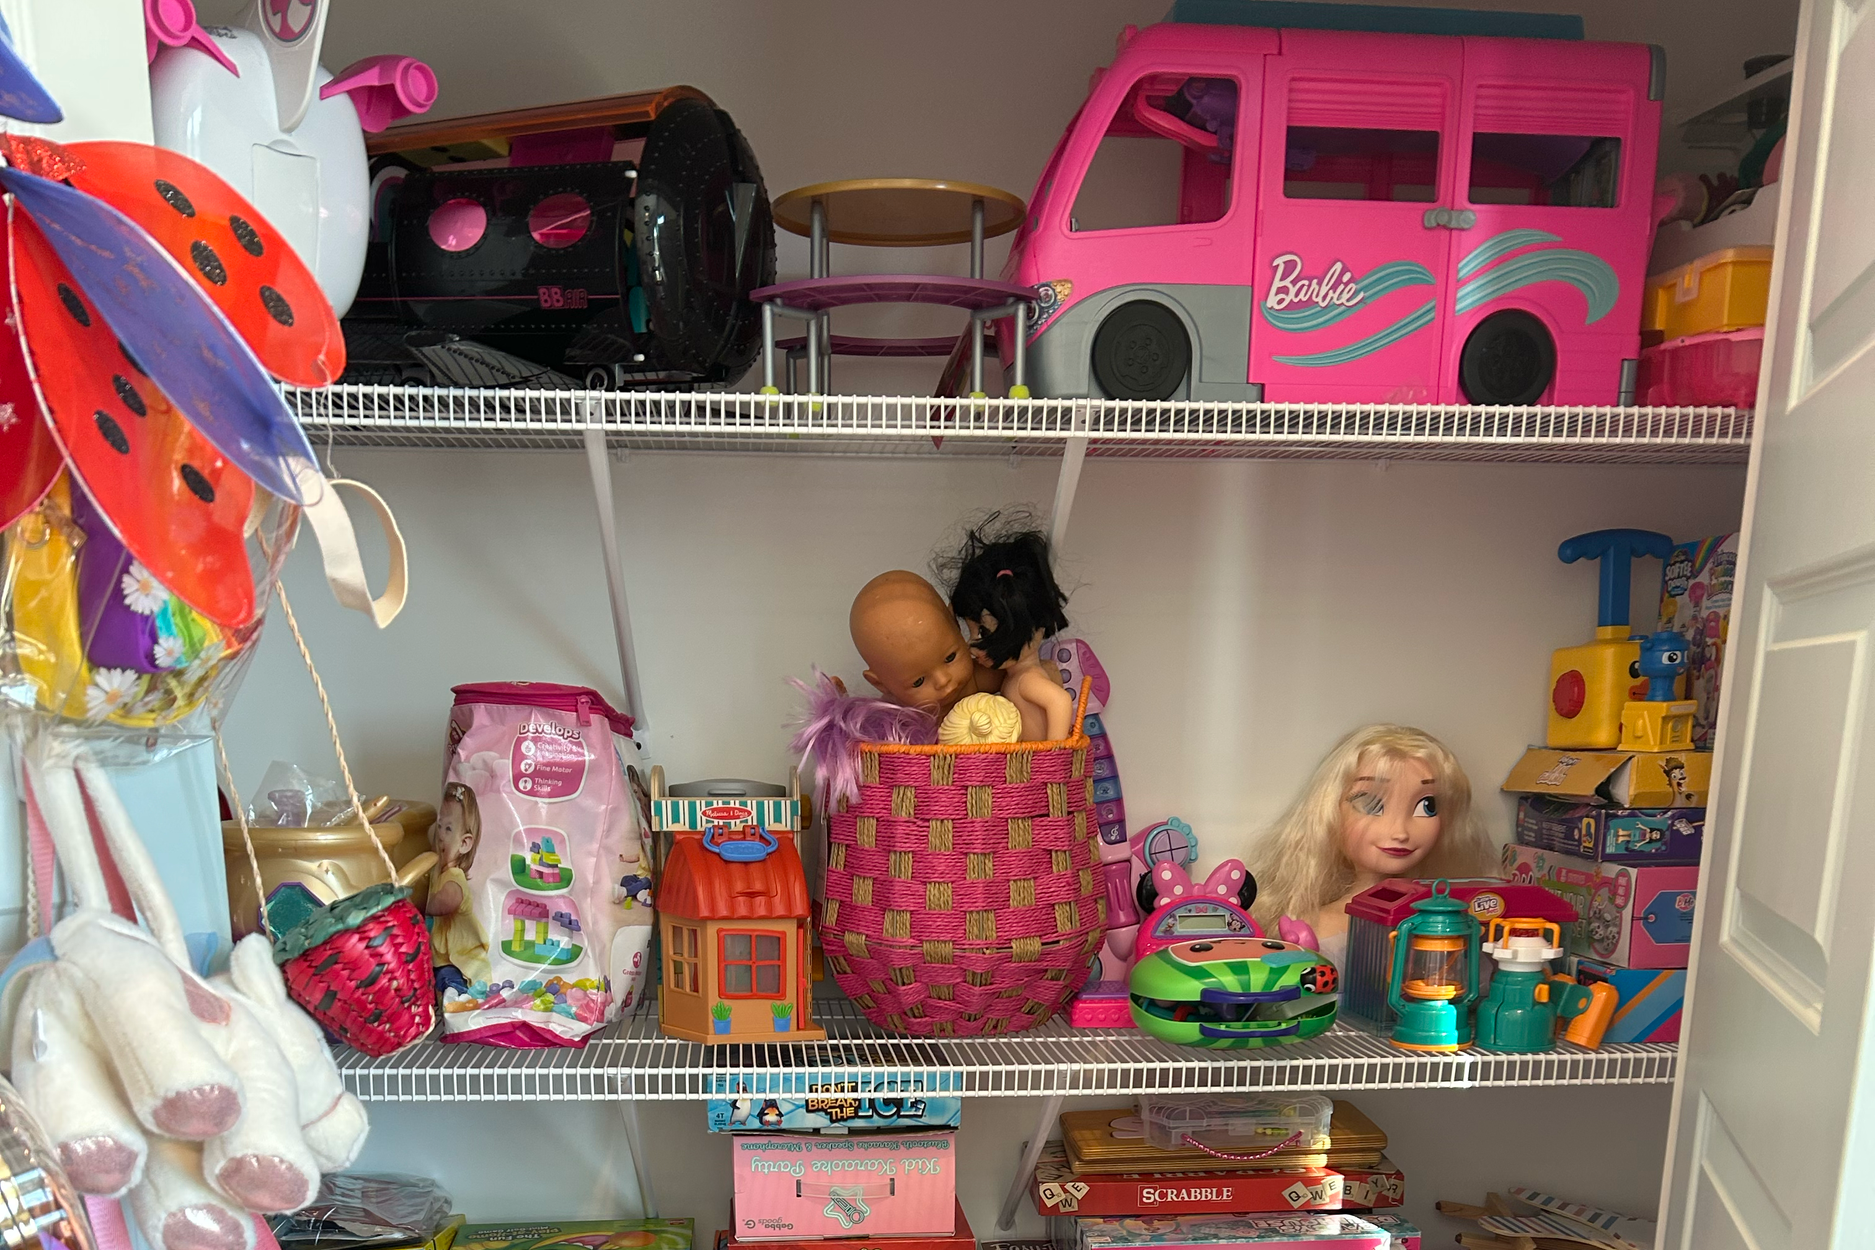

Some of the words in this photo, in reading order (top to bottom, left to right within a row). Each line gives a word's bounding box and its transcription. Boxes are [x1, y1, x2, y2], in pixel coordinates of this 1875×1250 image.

[1266, 253, 1364, 310] Barbie
[519, 722, 581, 740] Develops
[552, 765, 573, 773] Motor
[535, 778, 562, 787] Thinking
[1474, 897, 1499, 912] Live
[808, 1098, 859, 1111] BREAK
[858, 1081, 925, 1116] ICE
[827, 1107, 856, 1121] THE
[741, 1142, 803, 1151] Microphone
[805, 1142, 813, 1150] &
[815, 1141, 854, 1151] Speaker
[857, 1141, 900, 1151] Karaoke
[902, 1140, 950, 1150] Bluetooth
[751, 1157, 805, 1177] Party
[811, 1158, 897, 1175] Karaoke
[900, 1158, 941, 1175] Kid
[1142, 1187, 1233, 1203] SCRABBLE
[764, 1222, 794, 1230] Gabba
